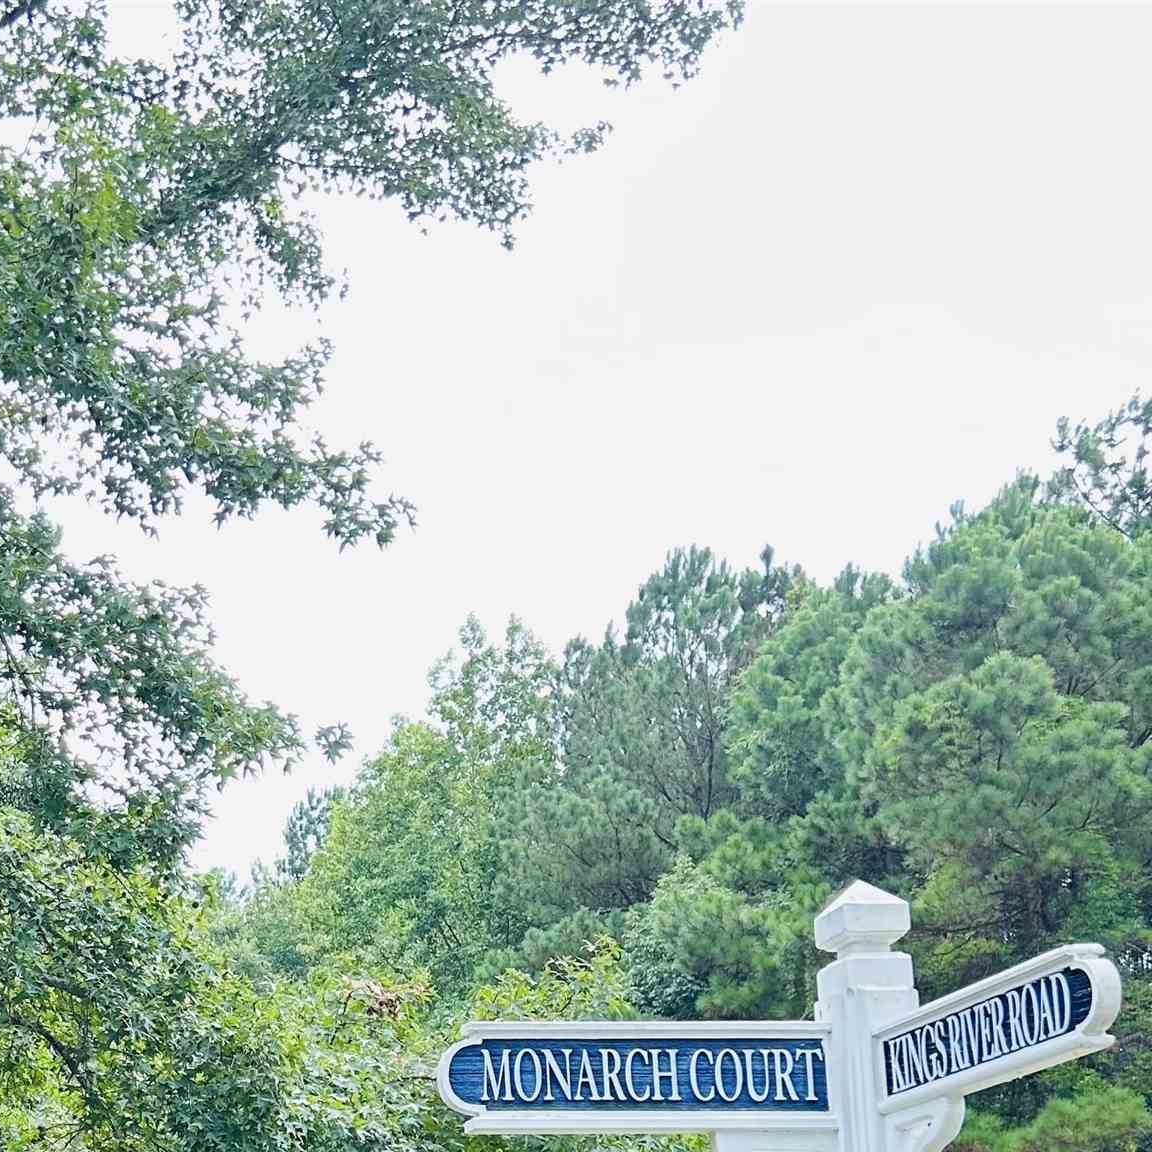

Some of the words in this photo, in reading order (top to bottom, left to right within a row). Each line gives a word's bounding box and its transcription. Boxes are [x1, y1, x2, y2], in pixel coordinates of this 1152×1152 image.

[480, 1047, 682, 1103] MONARCH
[688, 1047, 824, 1103] COURT
[888, 1020, 948, 1094] KINGS
[945, 997, 1005, 1074] RIVER
[1006, 972, 1072, 1053] ROAD
